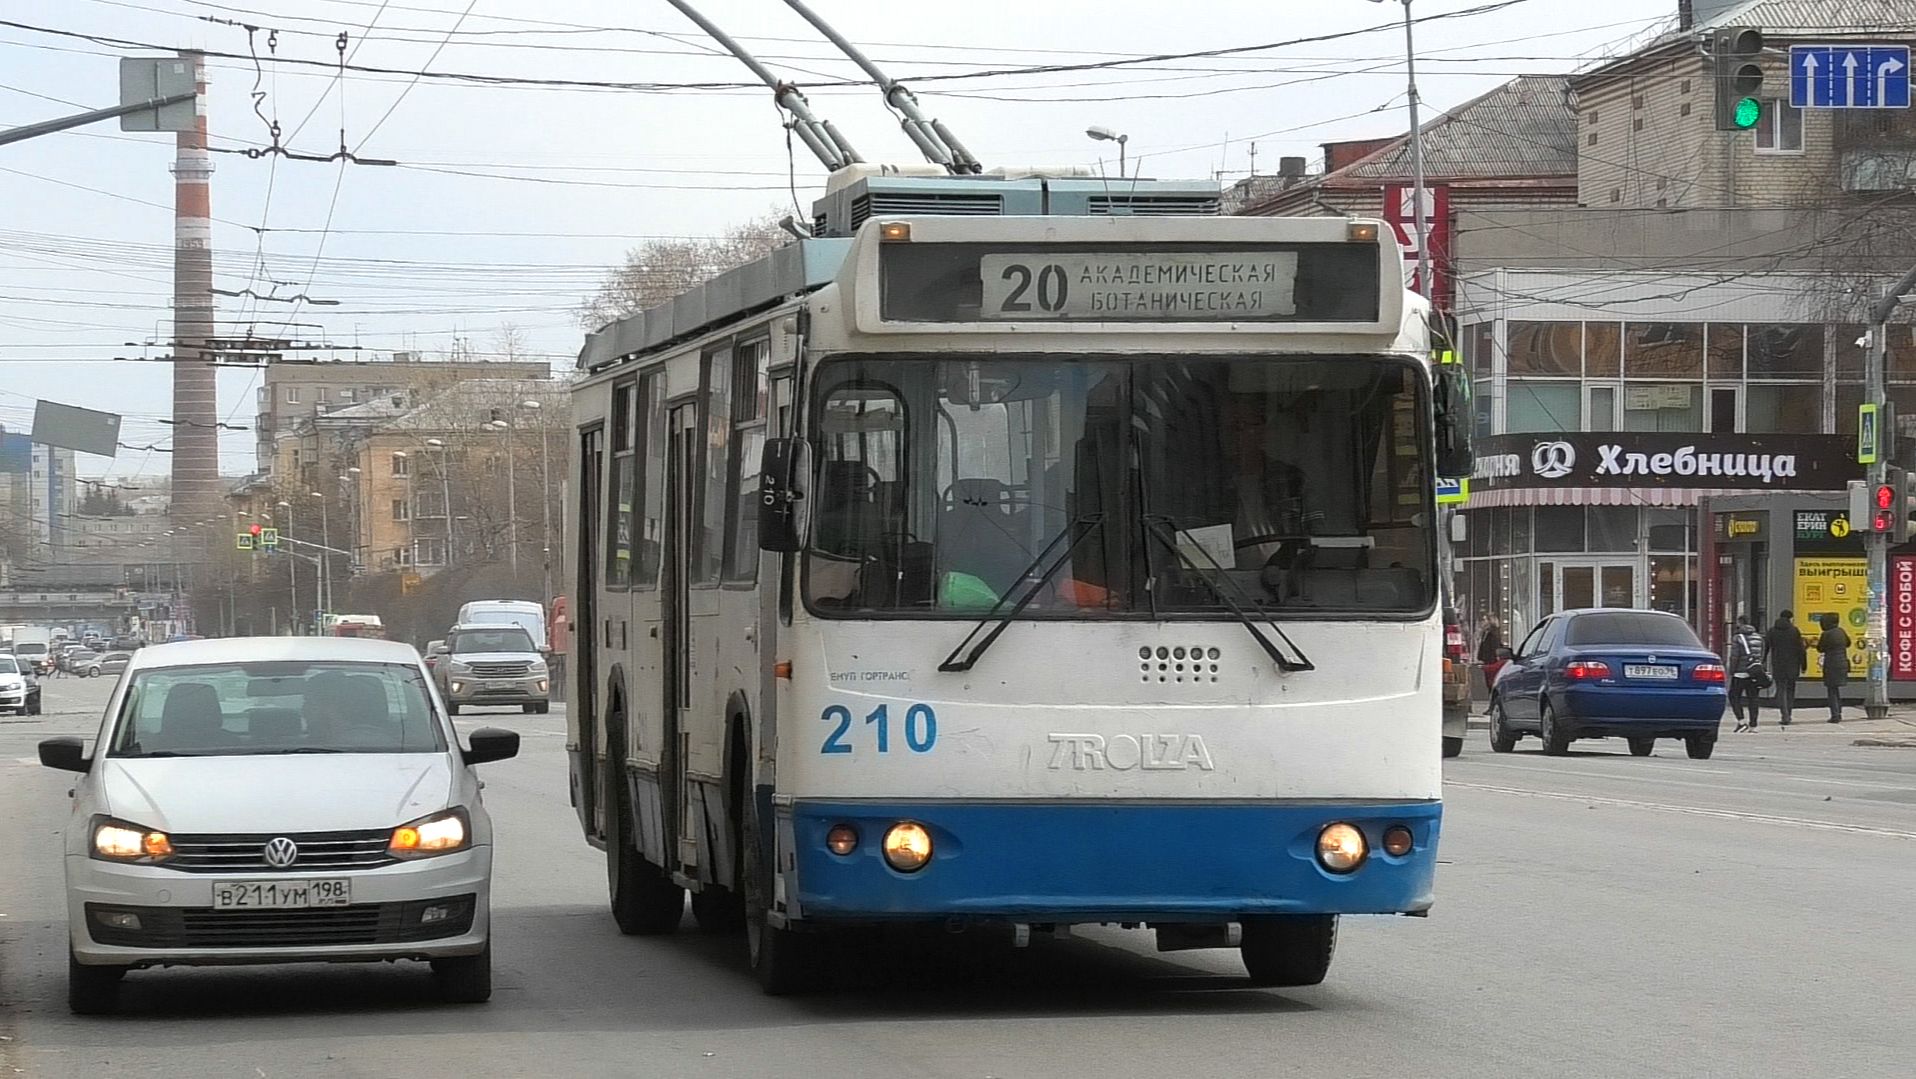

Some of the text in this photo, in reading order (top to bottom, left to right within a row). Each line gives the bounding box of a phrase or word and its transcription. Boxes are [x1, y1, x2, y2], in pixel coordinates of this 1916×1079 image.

[1001, 264, 1069, 312] 20
[1080, 263, 1276, 284] АКАДЕМИЧЕСКАЯ
[1090, 291, 1263, 311] БОТАНИЧЕСКАЯ
[1595, 444, 1797, 483] Хлебница
[763, 475, 775, 506] 210
[1896, 561, 1912, 672] КОФЕ С СОБОЙ
[820, 703, 937, 754] 210
[1048, 733, 1214, 771] TROLZA
[221, 882, 343, 906] В211УМ 198
